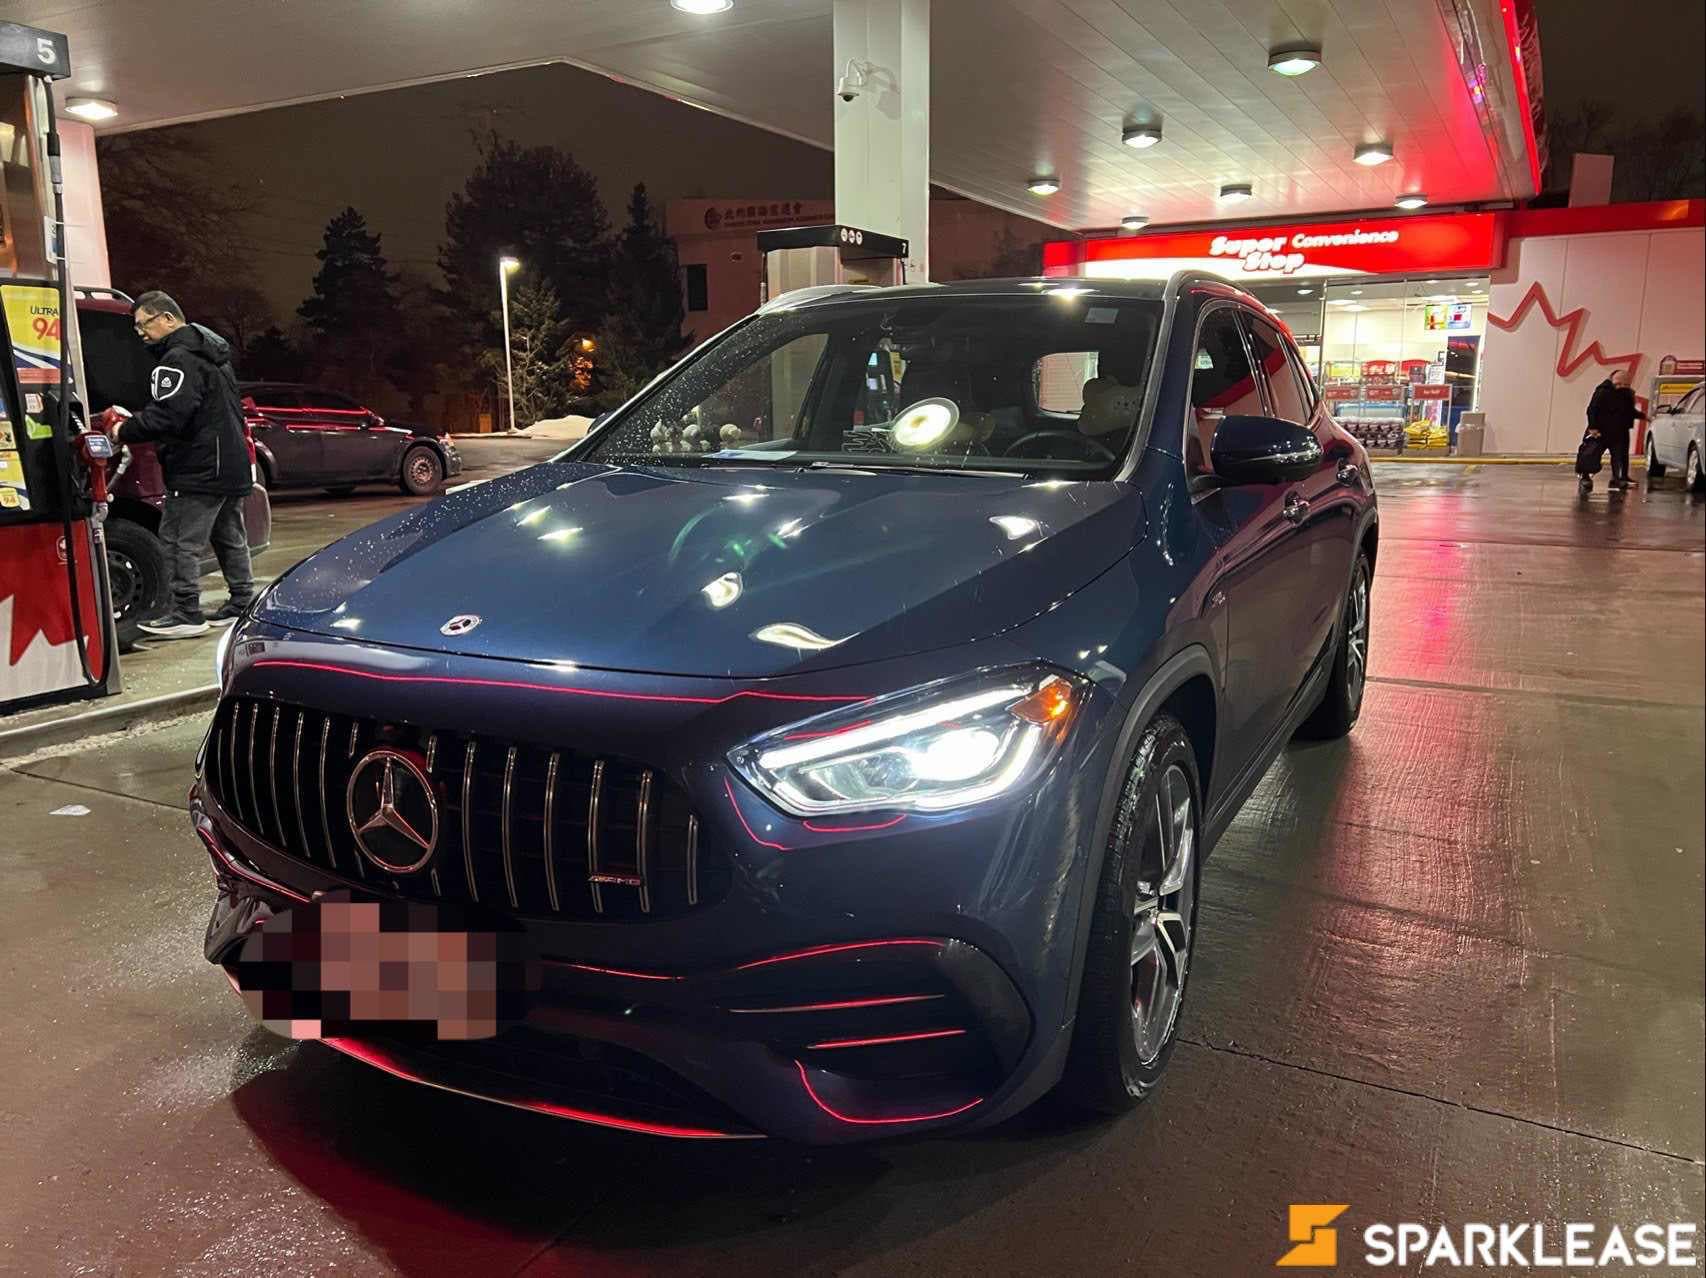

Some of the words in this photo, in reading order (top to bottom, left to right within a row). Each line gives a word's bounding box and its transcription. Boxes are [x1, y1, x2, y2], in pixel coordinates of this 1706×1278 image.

[36, 37, 57, 64] 5
[902, 242, 907, 254] 7
[1209, 235, 1288, 258] Super
[1291, 229, 1400, 249] Convenience
[1243, 252, 1306, 274] Stop
[30, 305, 59, 317] ULTRA
[32, 317, 61, 340] 94
